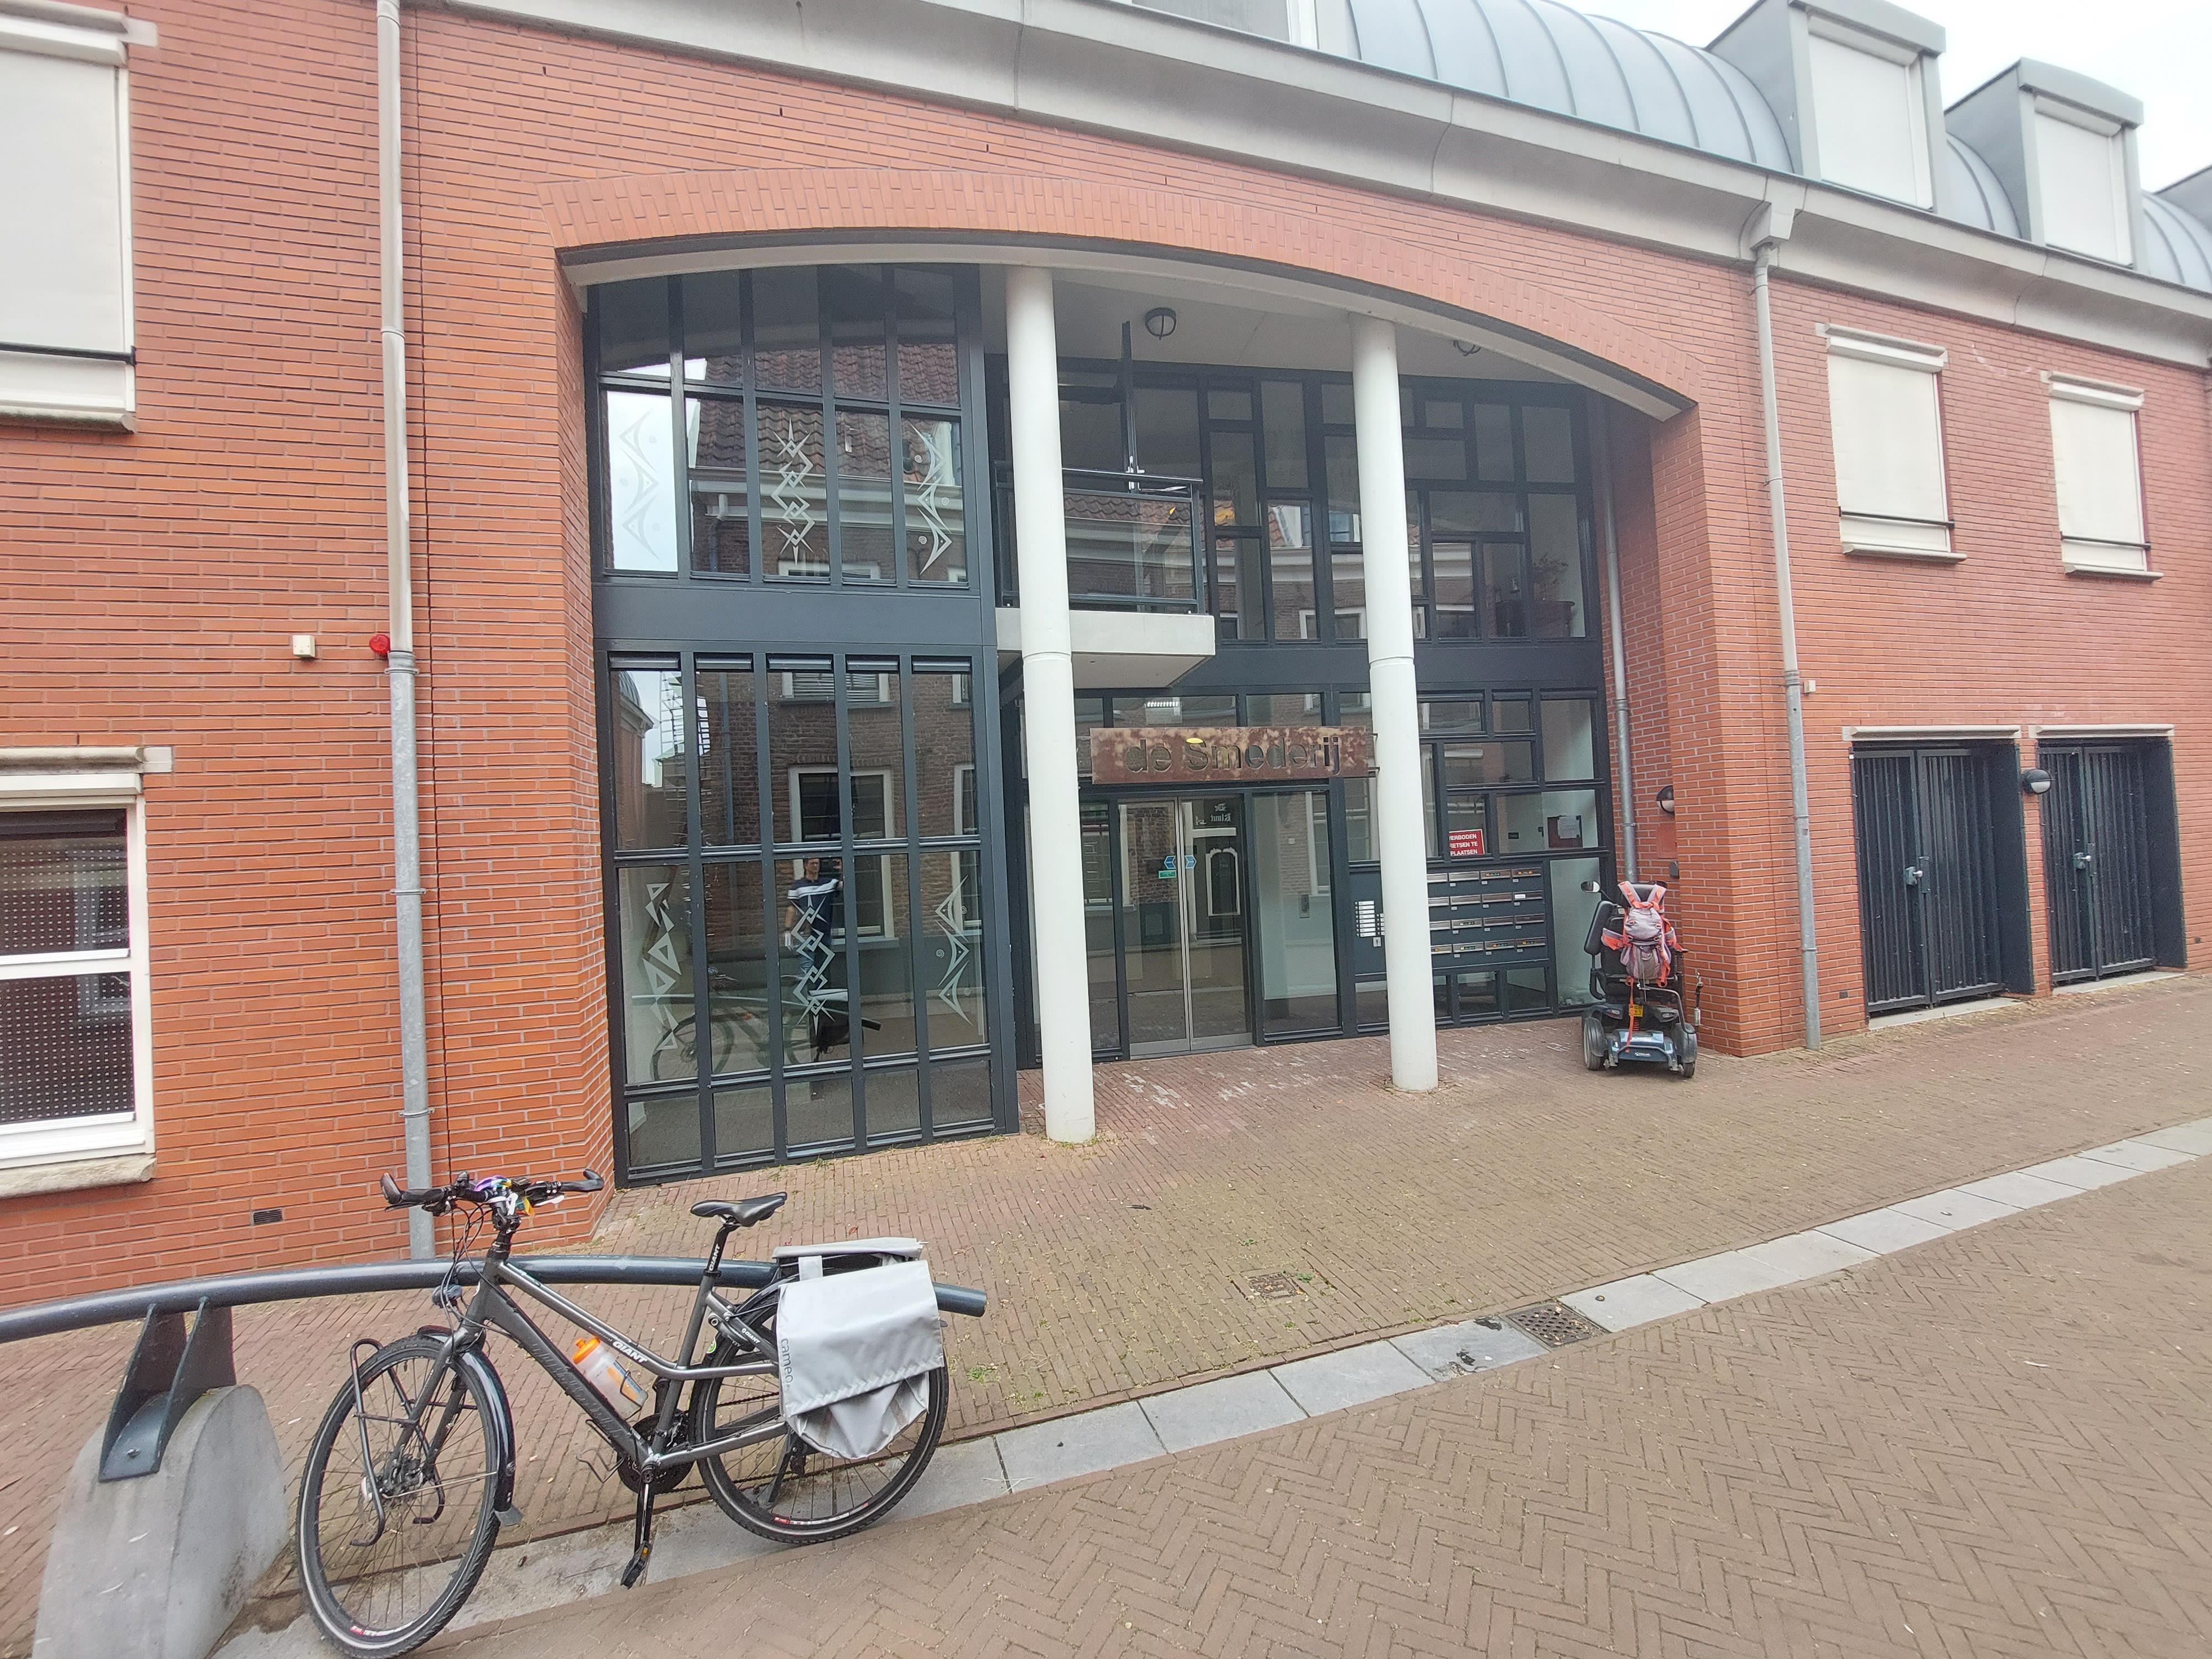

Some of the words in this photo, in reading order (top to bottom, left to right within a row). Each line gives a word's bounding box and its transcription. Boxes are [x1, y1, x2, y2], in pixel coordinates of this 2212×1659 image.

[1125, 739, 1172, 773] de
[1185, 737, 1340, 776] Smederij
[709, 1244, 721, 1271] GIANT
[745, 1330, 761, 1344] GIANT
[612, 1340, 648, 1363] GIANT
[781, 1339, 793, 1383] cameo
